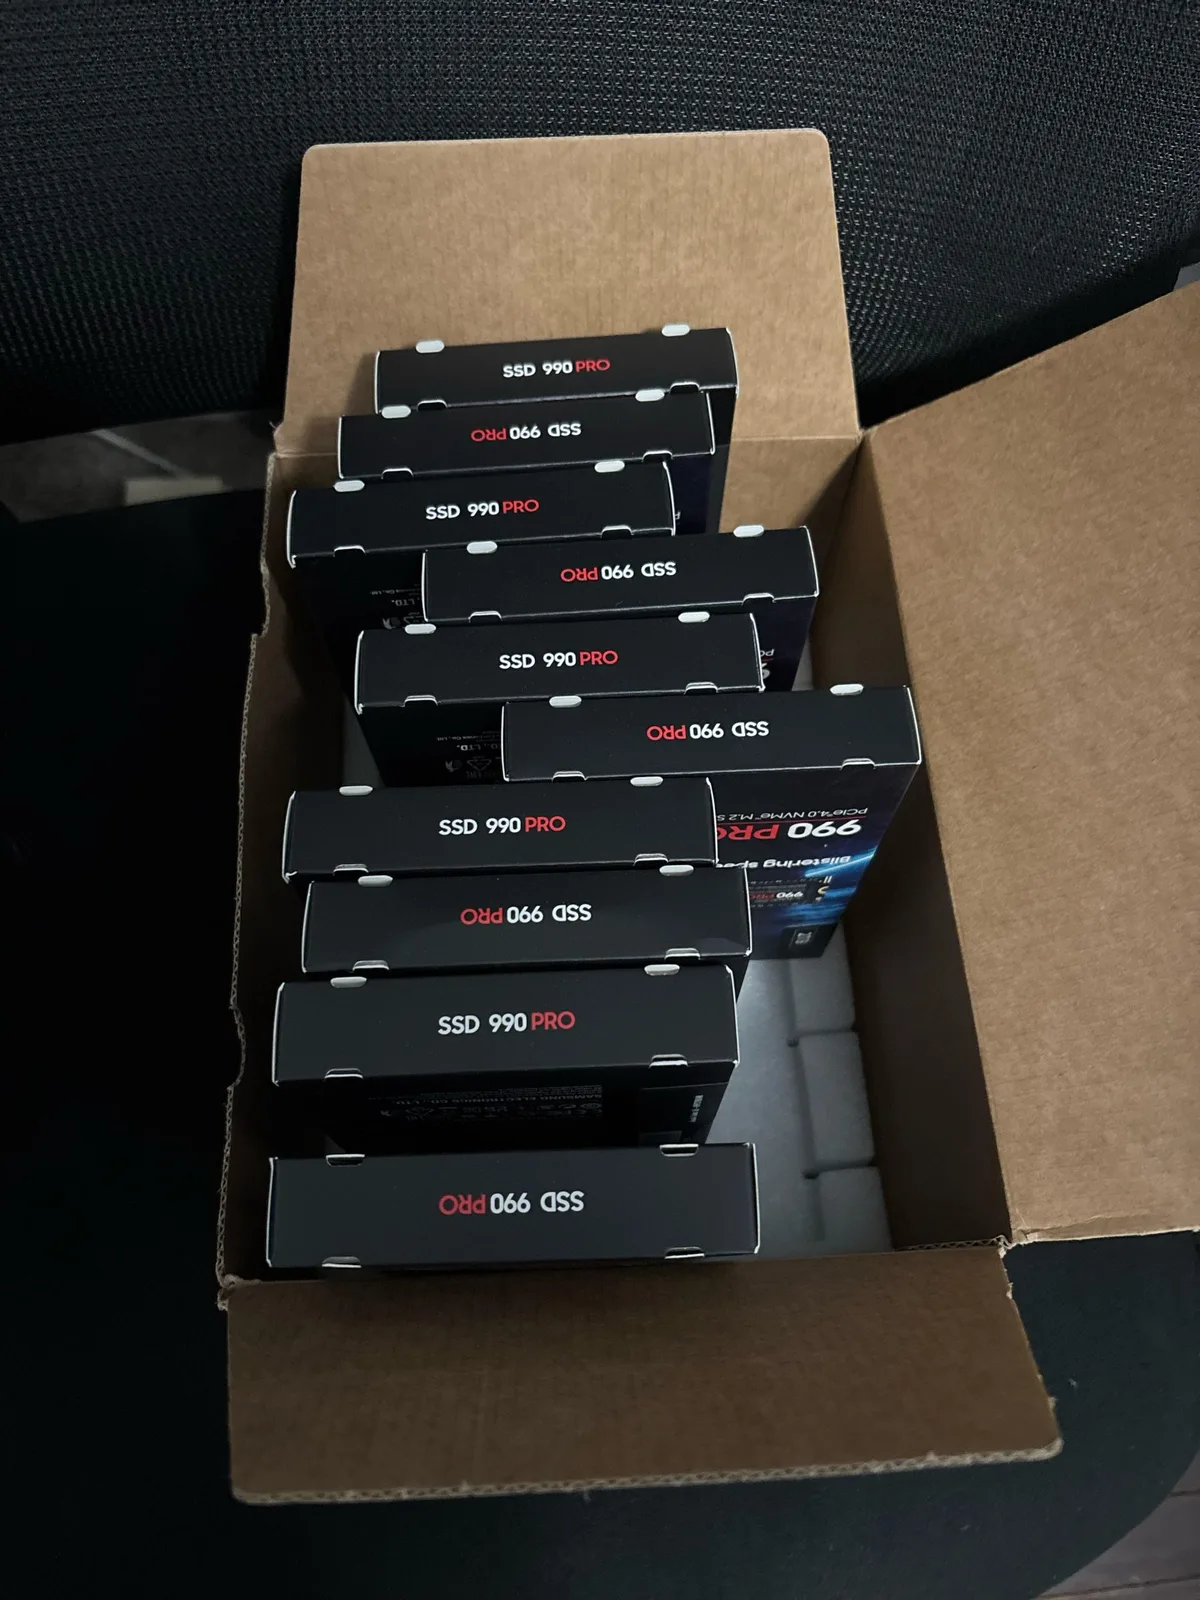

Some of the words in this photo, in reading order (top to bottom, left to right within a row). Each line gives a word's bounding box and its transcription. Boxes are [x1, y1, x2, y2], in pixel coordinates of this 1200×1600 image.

[502, 362, 536, 379] SSD
[541, 360, 574, 376] 990
[575, 358, 611, 374] PRO
[470, 427, 507, 443] PRO
[509, 424, 542, 441] 990
[547, 421, 582, 438] SSD
[425, 503, 461, 521] SSD
[467, 501, 500, 518] 990
[502, 498, 540, 515] PRO
[560, 566, 599, 584] PRO
[600, 563, 635, 581] 990
[640, 560, 677, 578] SSD
[498, 653, 536, 670] SSD
[542, 651, 577, 668] 990
[579, 649, 619, 667] PRO
[646, 724, 687, 741] PRO
[689, 722, 725, 740] 990
[730, 720, 770, 738] SSD
[438, 818, 478, 836] SSD
[485, 816, 522, 834] 990
[524, 815, 567, 833] PRO
[729, 813, 754, 821] M.2
[787, 819, 862, 838] 990
[762, 855, 851, 868] Blistering
[460, 907, 504, 925] PRO
[506, 905, 544, 924] 990
[551, 903, 592, 922] SSD
[437, 1014, 481, 1036] SSD
[488, 1012, 528, 1033] 990
[531, 1010, 576, 1031] PRO
[439, 1194, 486, 1215] PRO
[489, 1192, 532, 1215] 990
[539, 1190, 585, 1213] SSD
